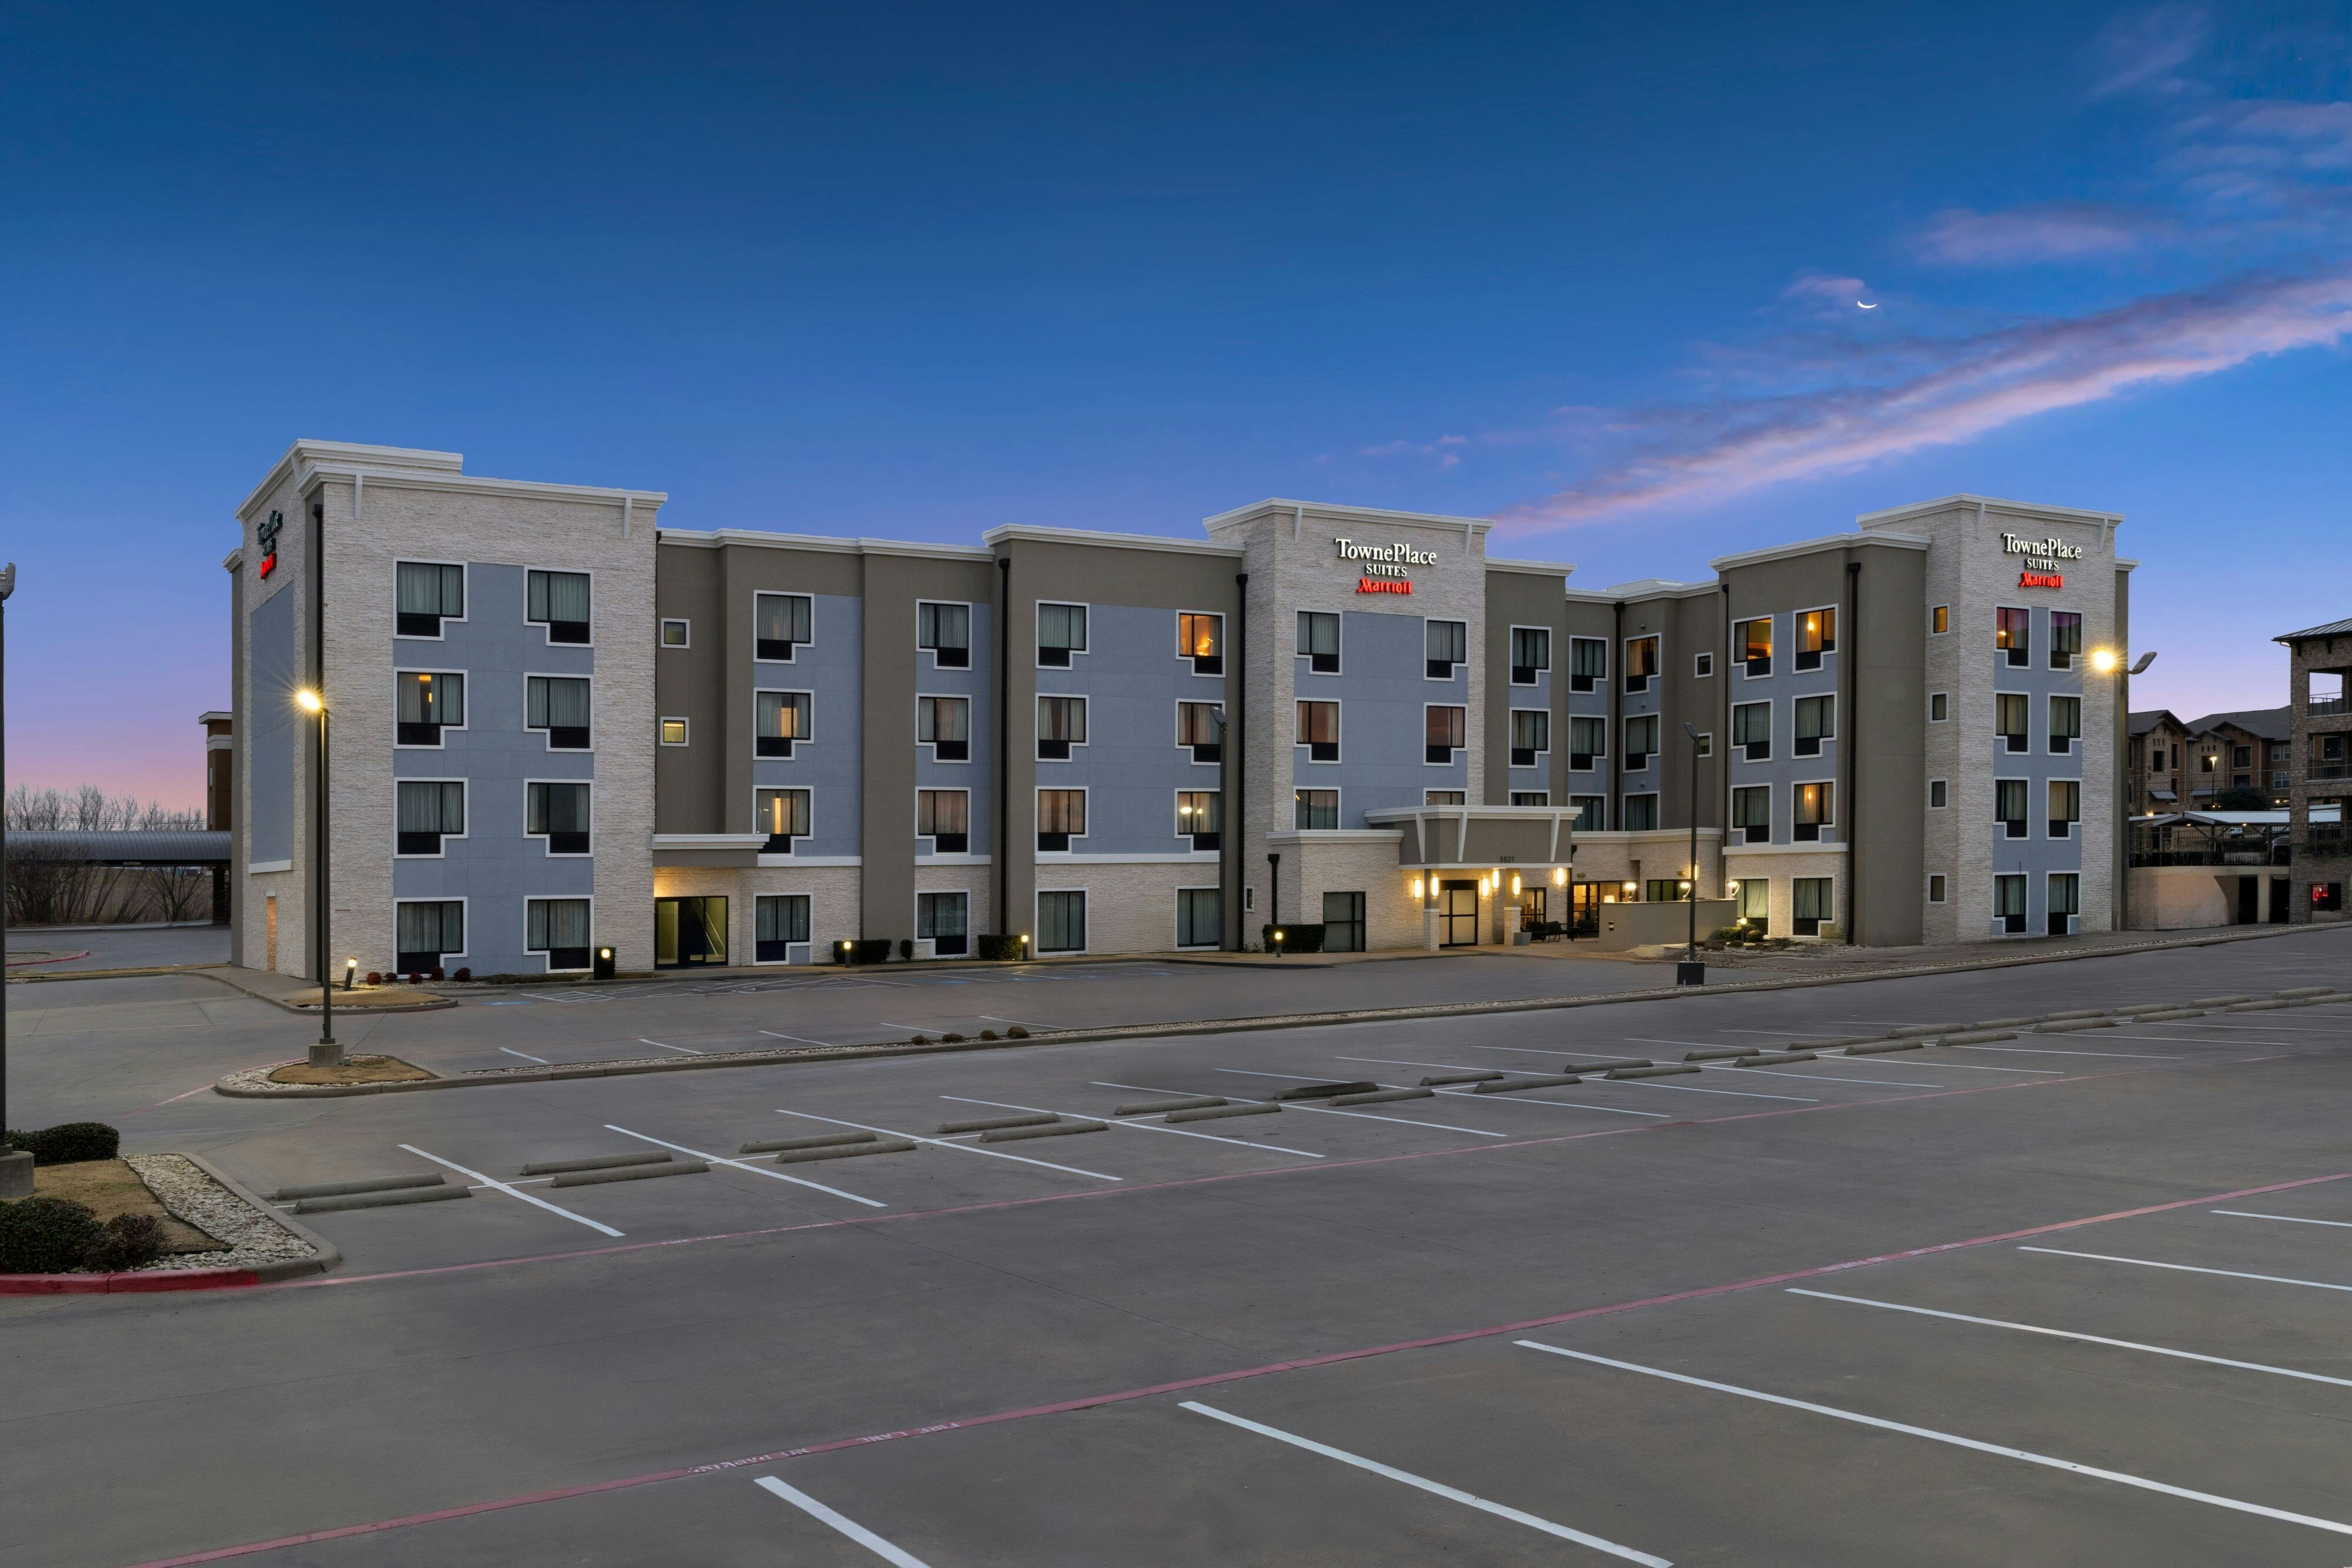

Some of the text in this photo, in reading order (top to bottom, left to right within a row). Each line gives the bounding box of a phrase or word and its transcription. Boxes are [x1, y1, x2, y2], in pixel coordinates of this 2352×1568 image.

[1334, 537, 1437, 565] TownePlace
[2002, 532, 2082, 559] TownePlace
[1365, 563, 1408, 577] SUITES
[2026, 558, 2059, 571] SUITES
[1358, 578, 1413, 594] Marriott
[2018, 572, 2063, 587] Marriott
[914, 1422, 960, 1433] FIRE
[856, 1431, 908, 1442] LANE
